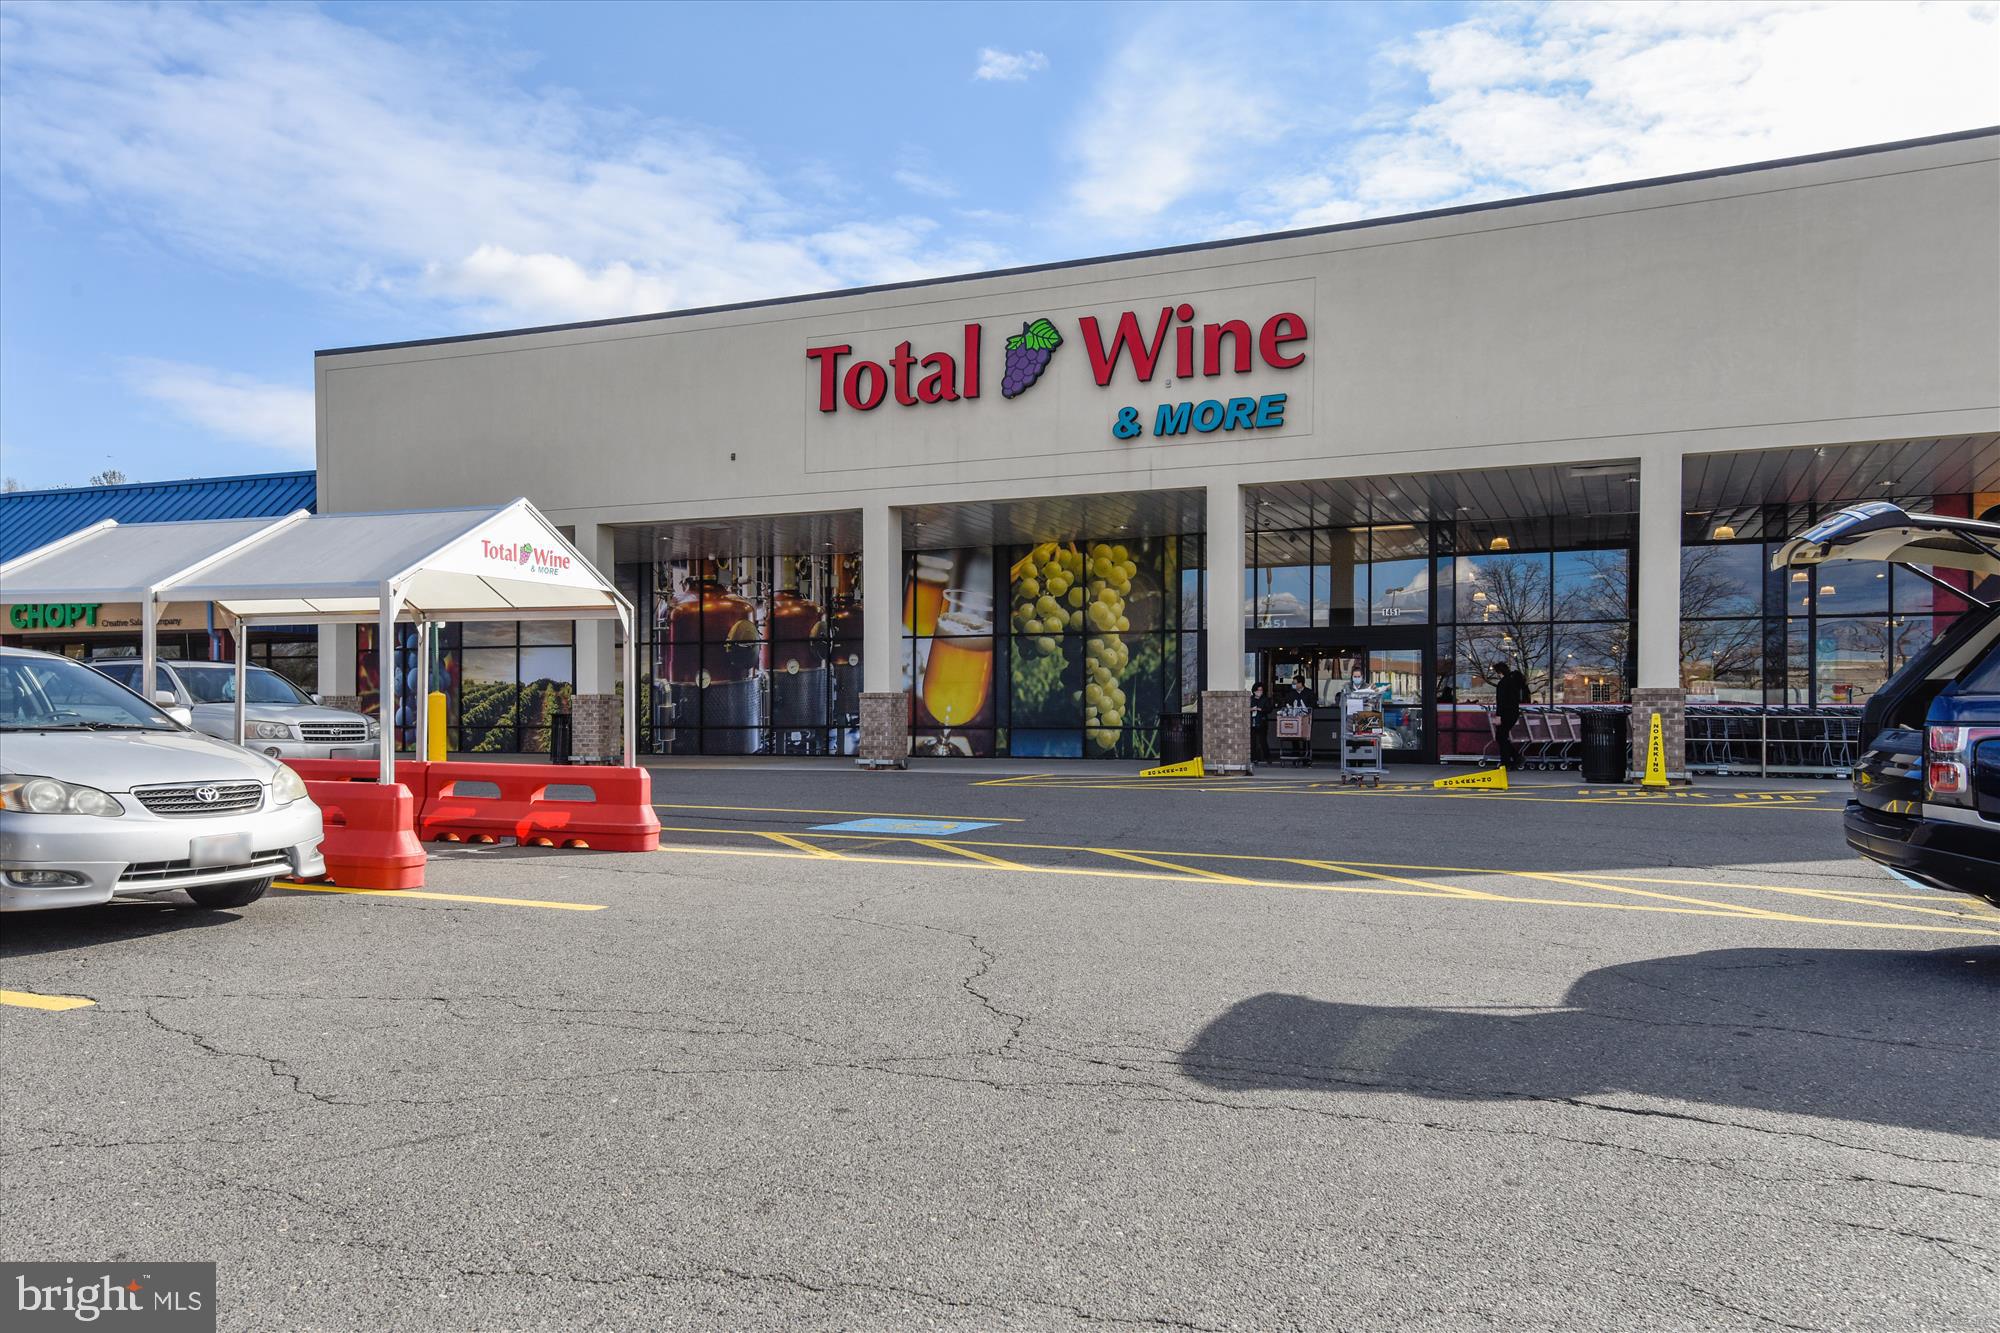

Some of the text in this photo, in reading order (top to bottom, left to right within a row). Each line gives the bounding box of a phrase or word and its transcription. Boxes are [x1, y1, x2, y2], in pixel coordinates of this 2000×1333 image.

[806, 303, 1308, 414] Total Wine
[1112, 393, 1288, 440] & MORE
[481, 540, 570, 569] Total Wine
[530, 565, 559, 576] & MORE
[10, 603, 101, 629] CHOPT
[1382, 607, 1401, 617] 1451
[101, 618, 129, 628] Creative
[129, 617, 144, 627] Sala
[1653, 724, 1659, 734] NO
[1455, 776, 1492, 784] PARKING
